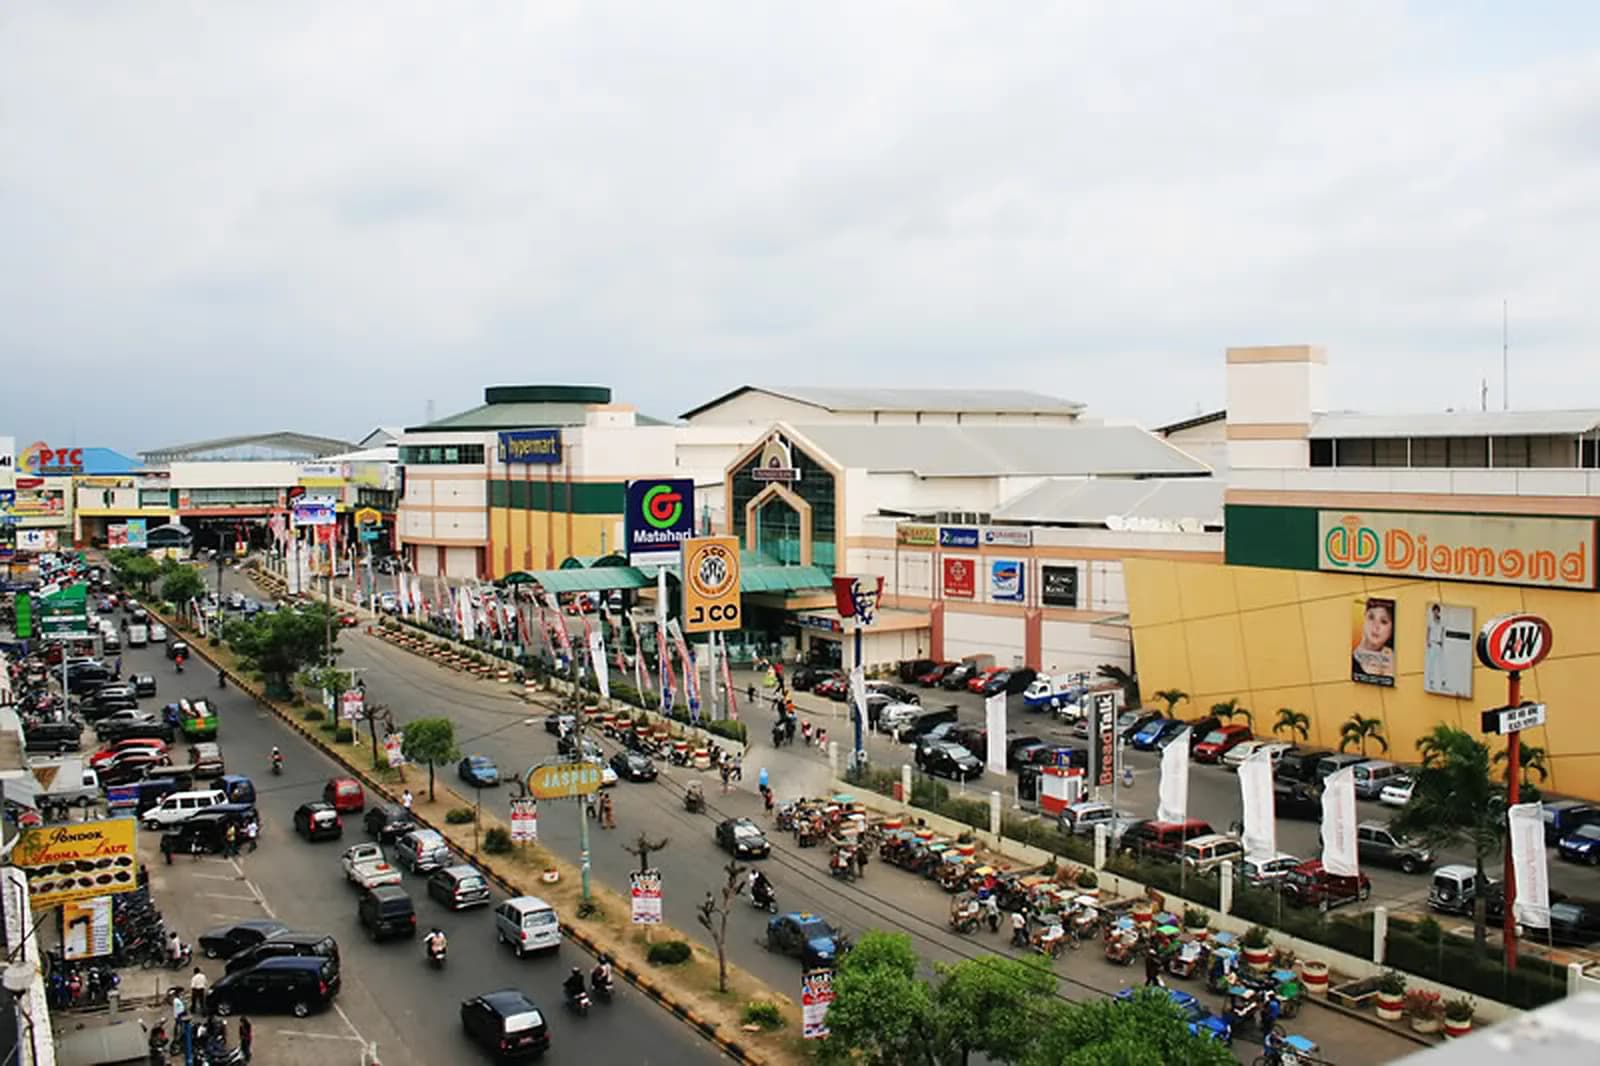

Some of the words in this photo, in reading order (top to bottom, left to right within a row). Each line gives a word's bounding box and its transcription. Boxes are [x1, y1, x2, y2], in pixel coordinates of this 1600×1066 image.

[40, 448, 82, 465] PTC
[633, 528, 692, 542] Matahari
[1384, 528, 1586, 582] Diamond
[1099, 694, 1113, 784] BreadTalk
